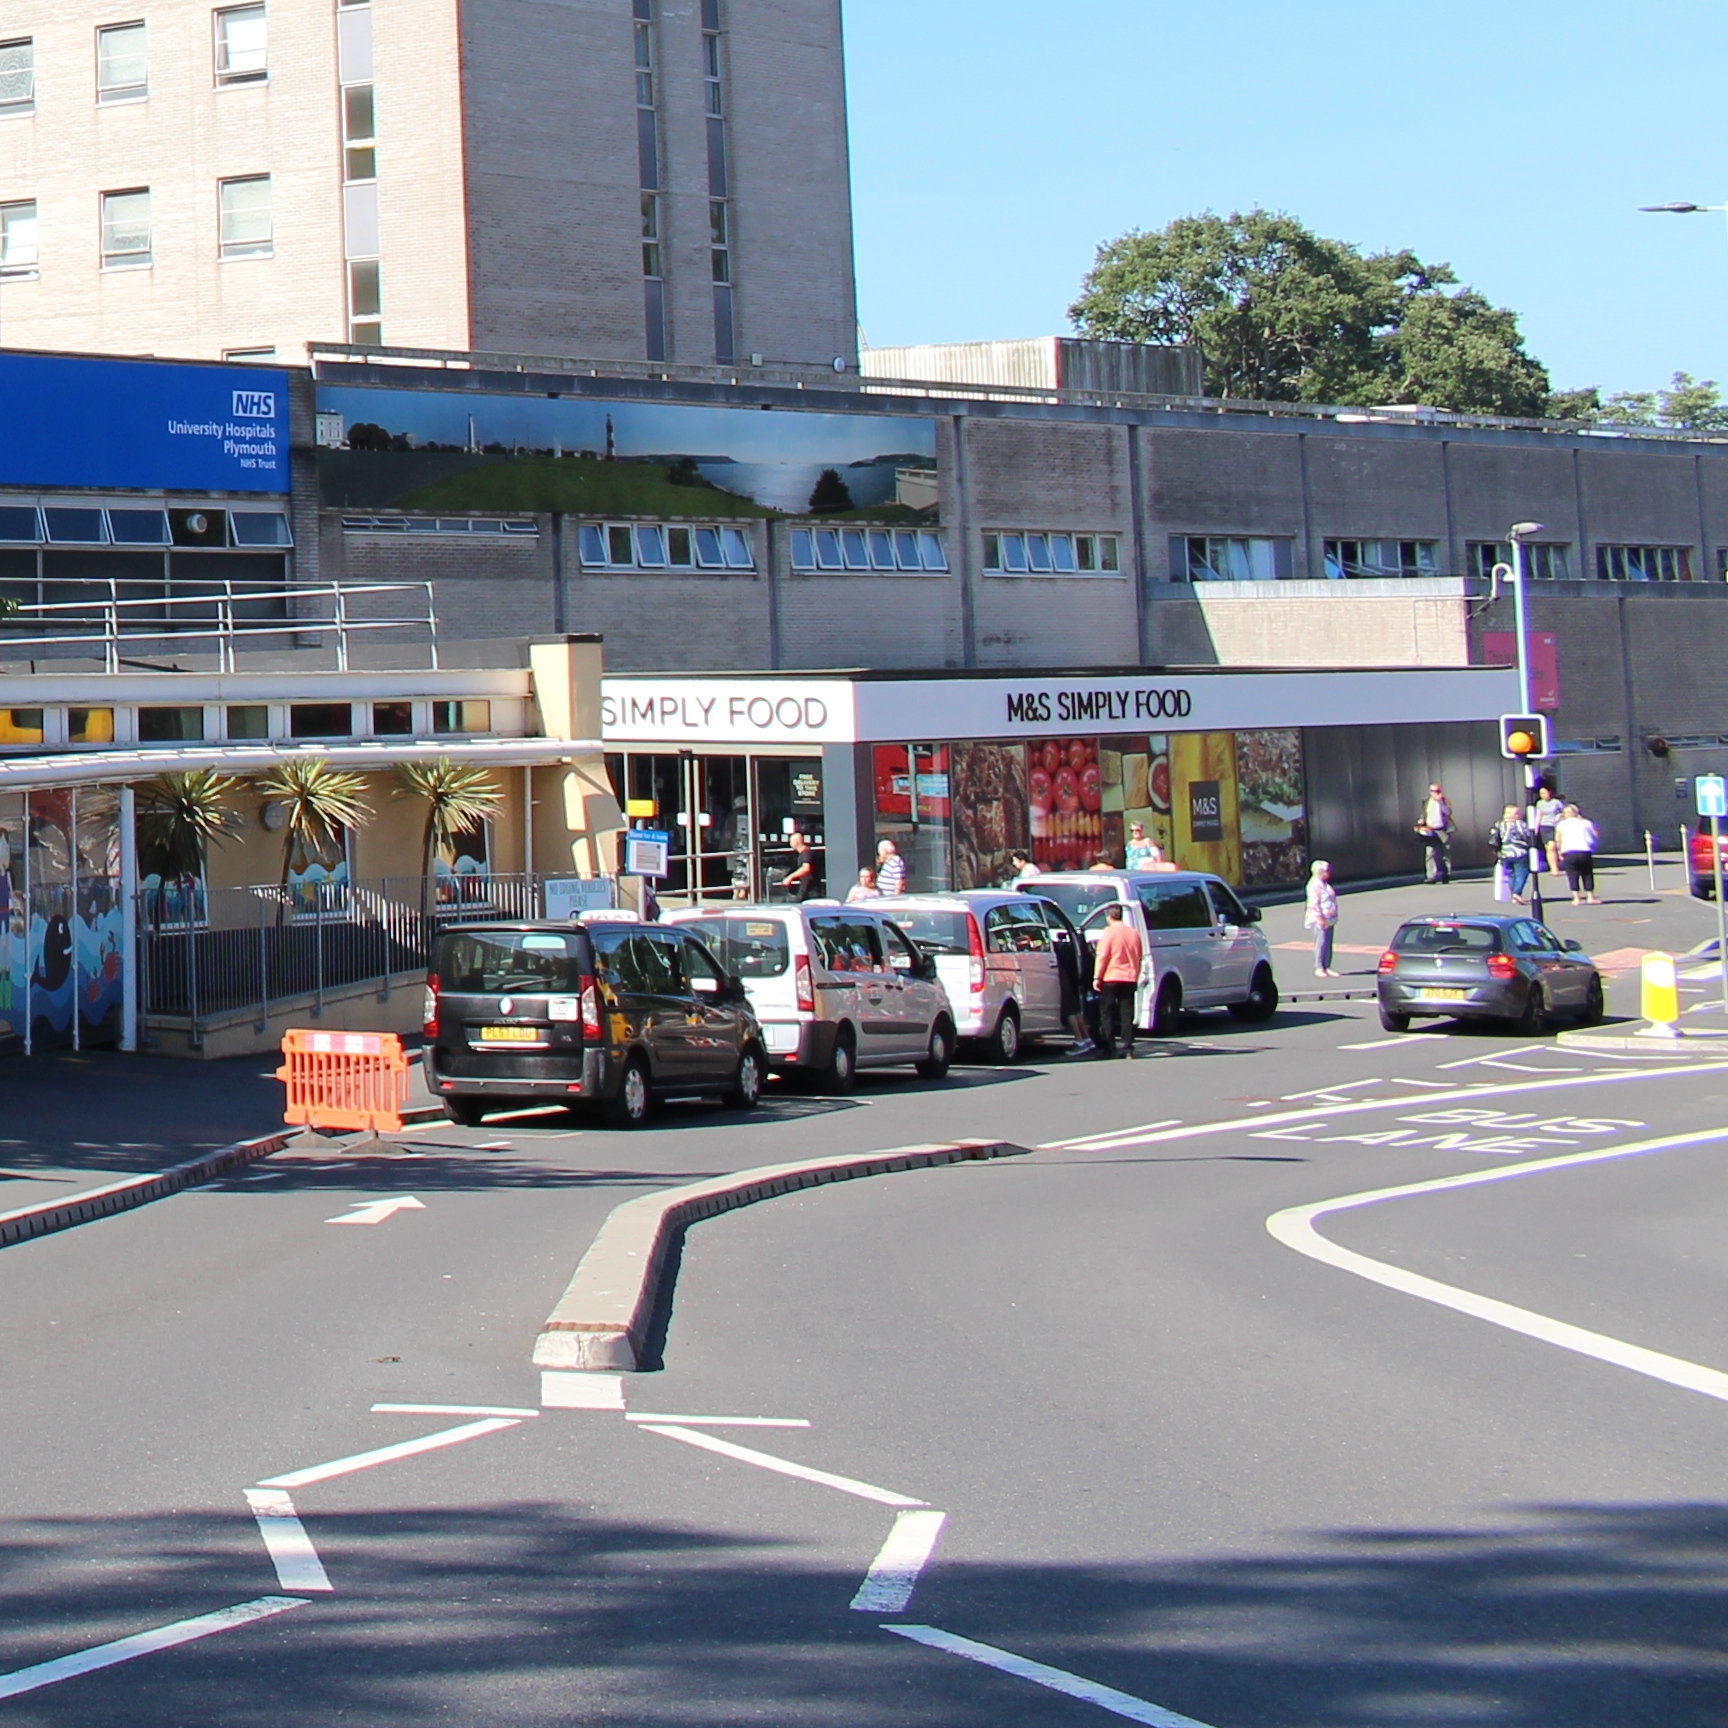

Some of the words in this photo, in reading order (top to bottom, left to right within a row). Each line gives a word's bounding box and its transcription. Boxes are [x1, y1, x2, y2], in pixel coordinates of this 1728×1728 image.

[234, 392, 273, 416] NHS
[168, 420, 223, 439] University
[225, 422, 276, 440] Hospitals
[224, 439, 276, 458] Plymouth
[241, 458, 256, 468] NHS
[258, 459, 276, 469] Trust
[601, 696, 716, 727] SIMPLY
[729, 697, 828, 729] FOOD
[1007, 693, 1051, 722] M&S
[1058, 691, 1129, 720] SIMPLY
[1135, 690, 1191, 718] FOOD
[1193, 797, 1217, 815] M&S
[1396, 1109, 1646, 1134] BUS
[1247, 1123, 1581, 1154] LANE
